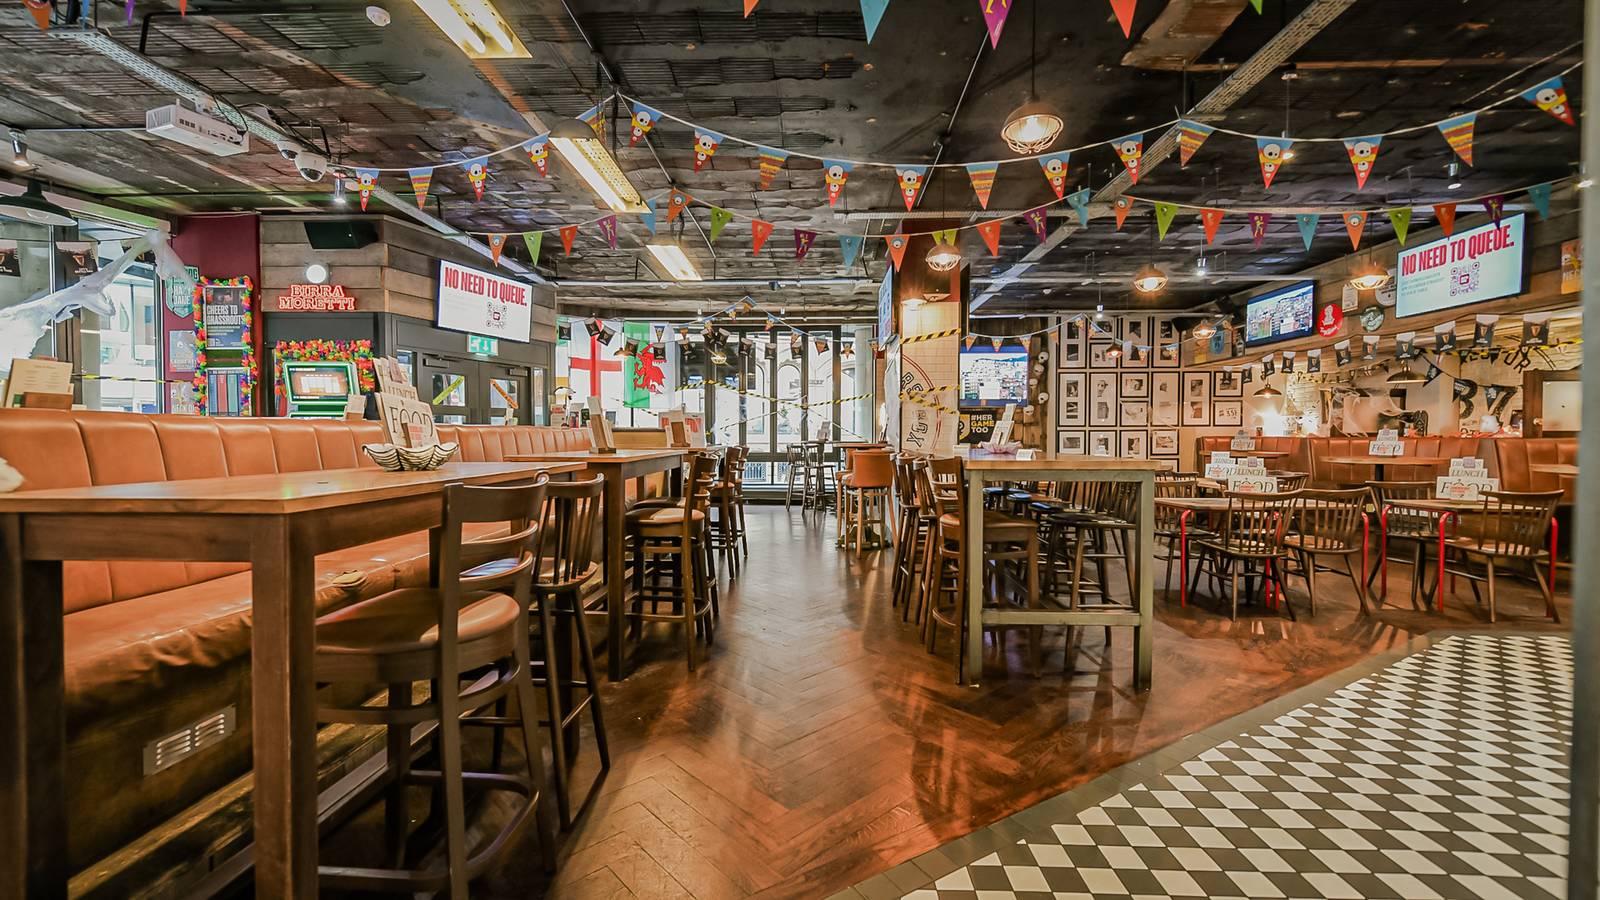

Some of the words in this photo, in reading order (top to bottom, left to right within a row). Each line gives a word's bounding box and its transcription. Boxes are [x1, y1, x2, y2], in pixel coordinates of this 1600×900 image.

[1402, 253, 1417, 276] NO
[1419, 244, 1447, 272] NEED
[1450, 238, 1466, 263] TO
[291, 285, 345, 298] BIRRA
[444, 267, 459, 289] NO
[461, 271, 485, 295] NEED
[487, 279, 498, 299] TO
[500, 283, 527, 306] QUEUE.
[207, 305, 229, 315] CHEERS
[230, 305, 239, 315] TO
[279, 297, 355, 310] MORETTI
